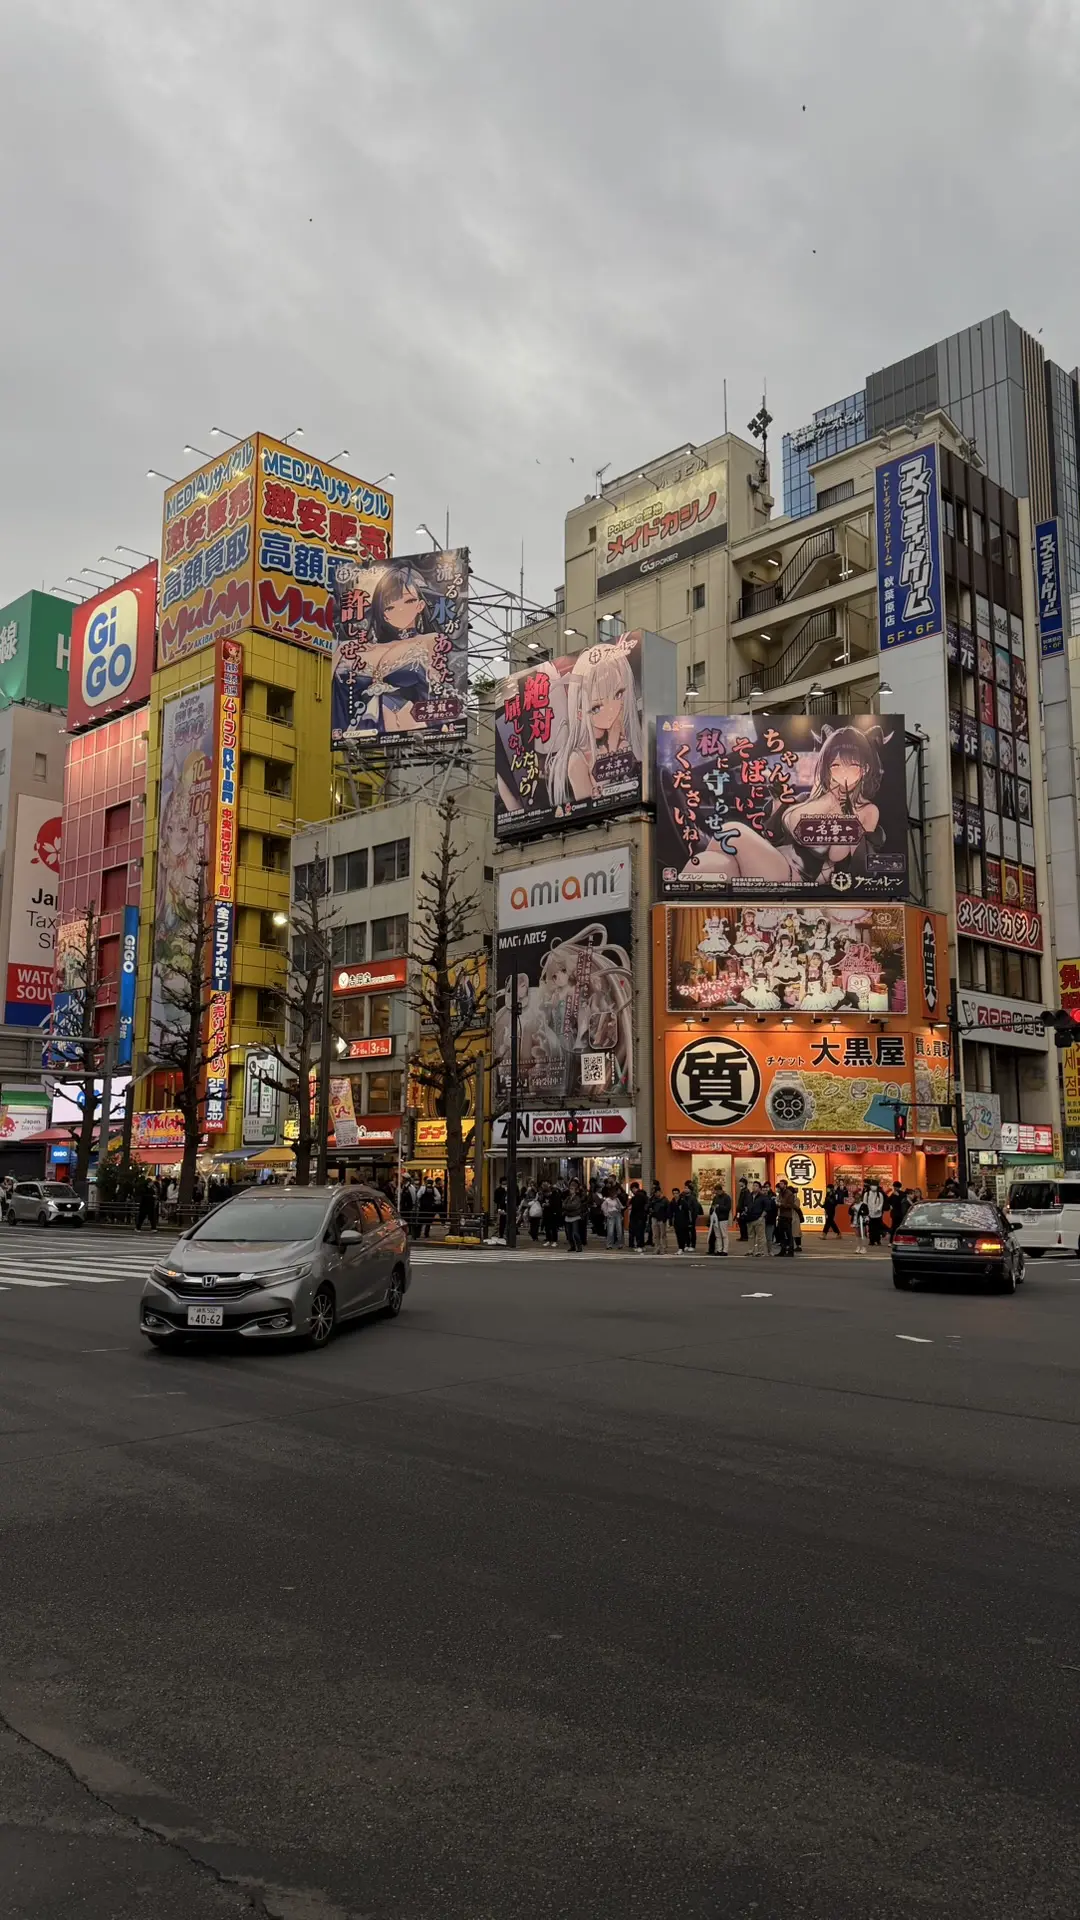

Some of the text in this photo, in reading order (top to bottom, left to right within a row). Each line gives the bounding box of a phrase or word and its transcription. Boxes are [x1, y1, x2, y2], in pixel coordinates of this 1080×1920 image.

[166, 441, 253, 522] MEDIAリサイクル
[262, 449, 389, 517] MEDIAリサイクル
[166, 479, 252, 564] 激安販売
[263, 480, 390, 562] 激安販売
[607, 491, 717, 563] メイドカジノ
[163, 526, 249, 608] 高額買取
[884, 576, 896, 627] 秋葉原店
[961, 648, 975, 669] 7F
[523, 672, 554, 744] 絶対
[964, 734, 978, 755] 6F
[763, 728, 799, 804] ちゃんと
[696, 728, 741, 856] 私に守らせて
[967, 825, 982, 846] 5F
[31, 888, 58, 910] Ja
[510, 868, 616, 910] amiami
[854, 876, 904, 889] アズールレーン
[957, 899, 1041, 945] メイドカジノ
[766, 1056, 805, 1067] チケット
[810, 1036, 907, 1067] 大黒屋
[208, 1078, 225, 1087] 2F
[682, 1049, 750, 1115] 質
[22, 1117, 41, 1126] Japan
[582, 1118, 603, 1133] ZIN
[789, 1158, 812, 1181] 質
[195, 1314, 221, 1325] 40-62
